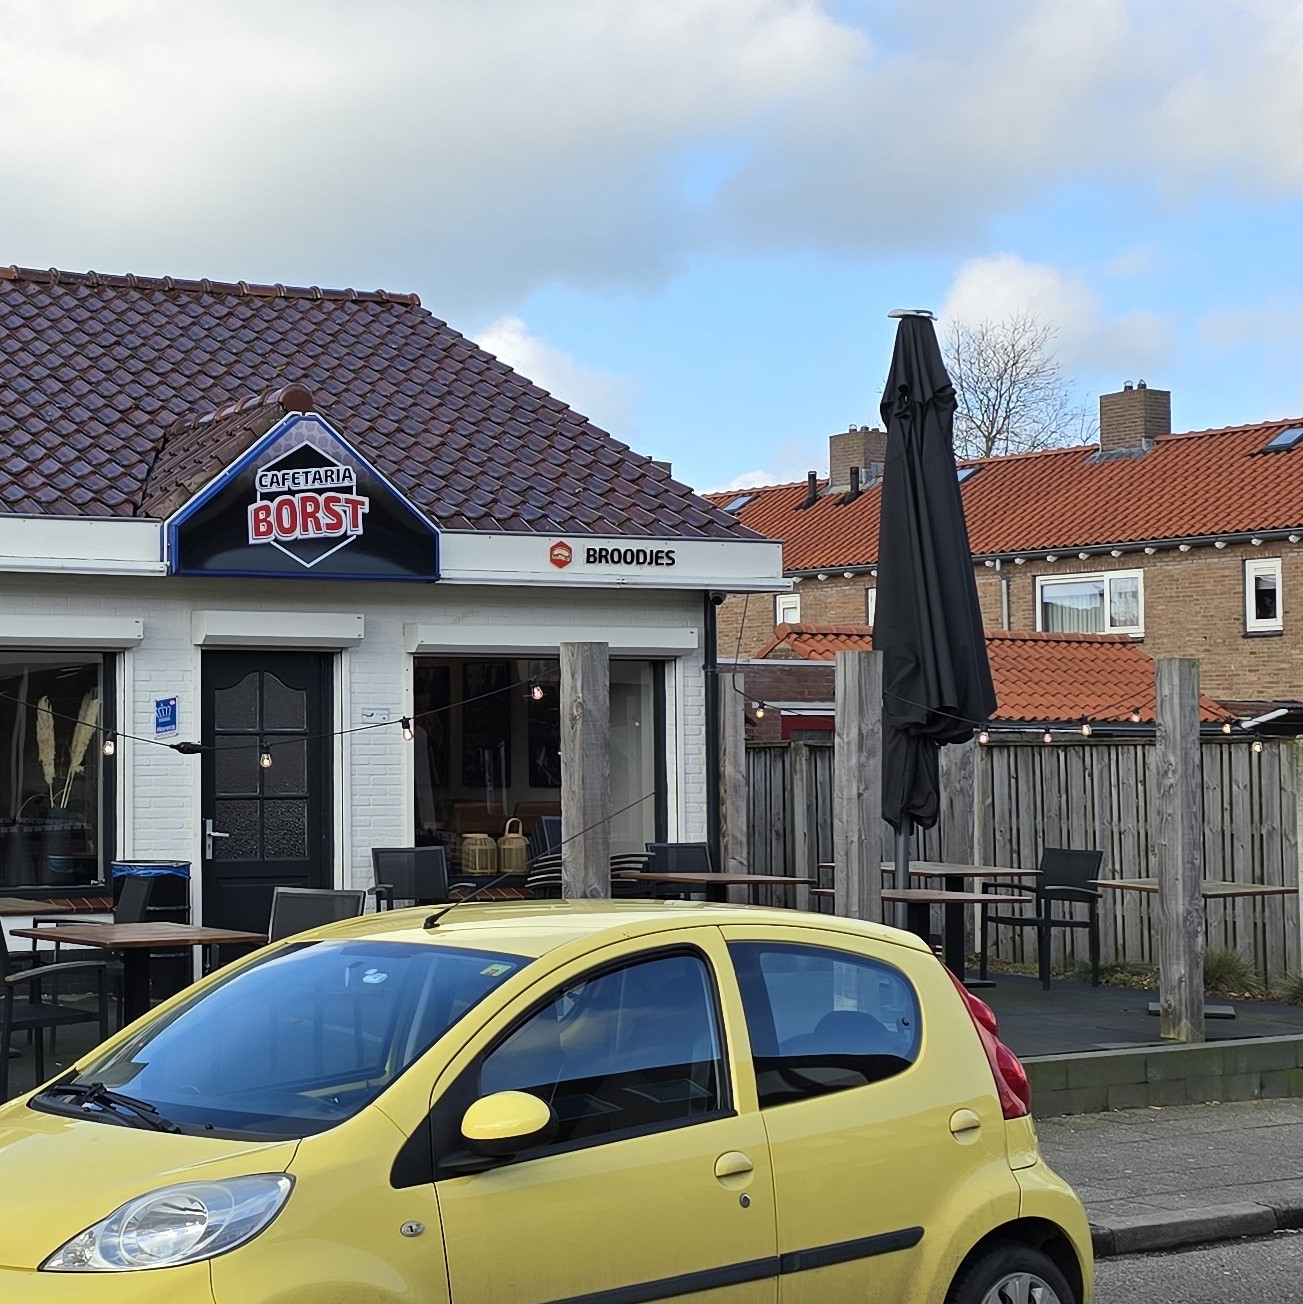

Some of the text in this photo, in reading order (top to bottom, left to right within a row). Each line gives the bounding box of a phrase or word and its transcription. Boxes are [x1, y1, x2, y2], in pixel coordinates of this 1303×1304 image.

[258, 467, 353, 488] CAFETARIA
[251, 494, 367, 539] BORST
[585, 547, 676, 566] BROODJES
